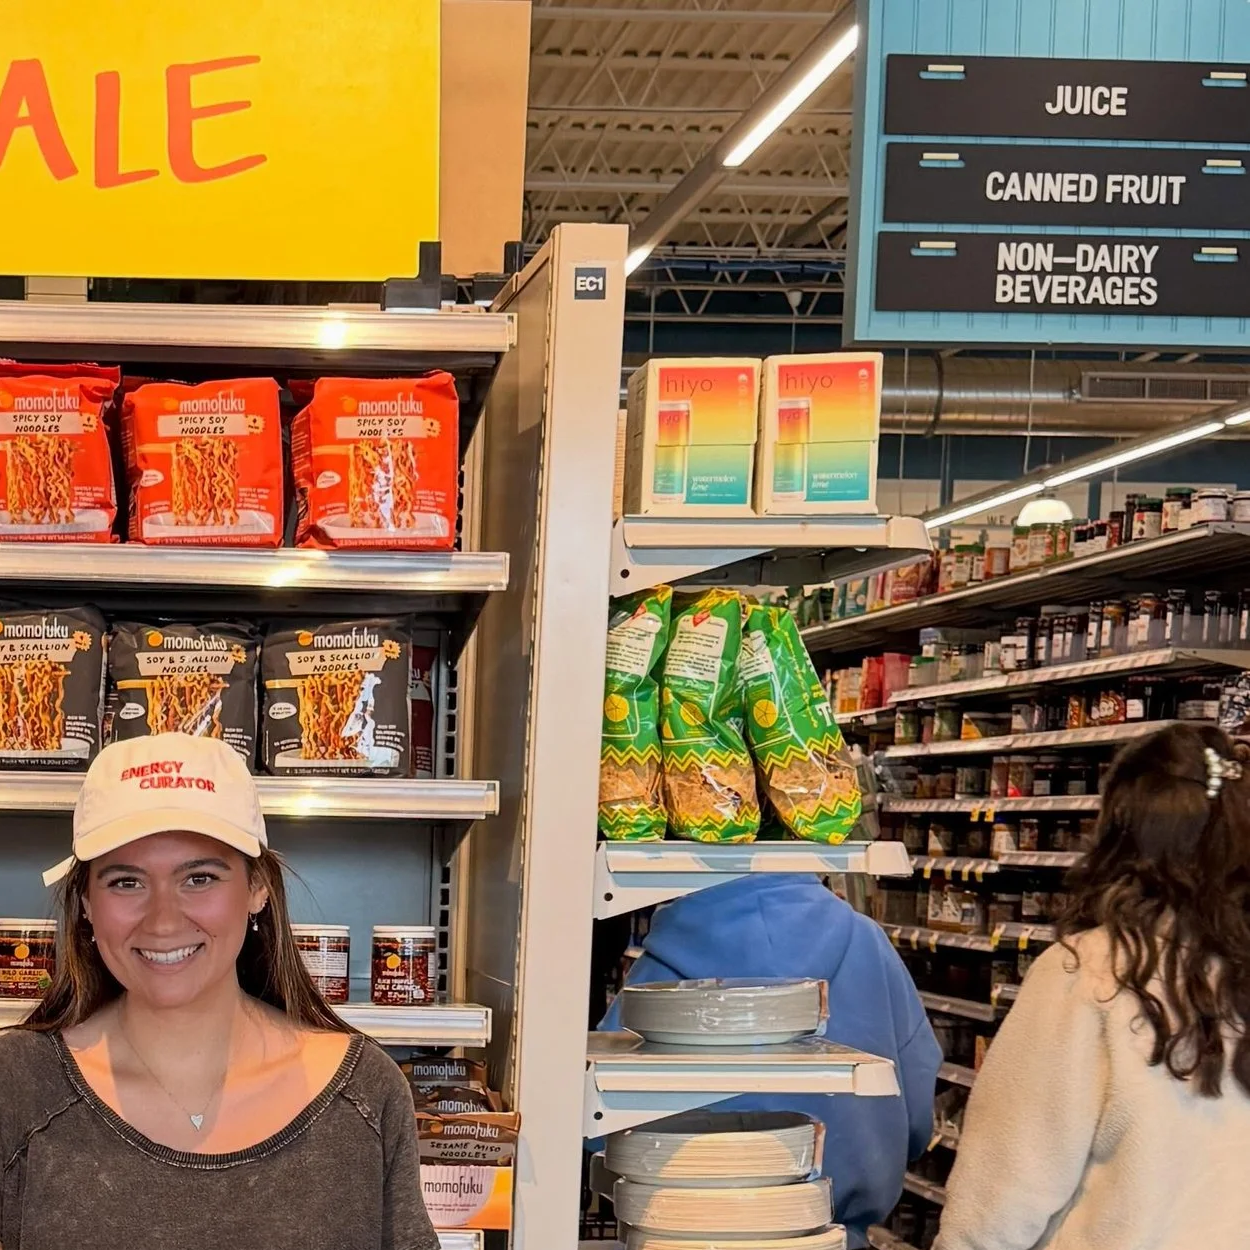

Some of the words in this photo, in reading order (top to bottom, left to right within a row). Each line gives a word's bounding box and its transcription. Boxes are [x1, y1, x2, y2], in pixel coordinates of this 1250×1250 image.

[1045, 85, 1128, 116] JUICE
[985, 171, 1098, 203] CANNED
[1105, 175, 1186, 205] FRUIT
[575, 276, 604, 291] EC1
[995, 275, 1158, 306] BEVERAGES
[665, 375, 713, 396] hiyo
[784, 371, 833, 393] hiyo
[14, 390, 80, 412] momofuku
[180, 392, 246, 414] momofuku
[358, 393, 423, 416] momofuku
[12, 414, 39, 423] SPICY
[43, 414, 63, 423] SOY
[178, 416, 204, 425] SPICY
[208, 416, 228, 425] SOY
[357, 418, 383, 427] SPICY
[387, 418, 407, 427] SOY
[15, 425, 60, 433] NOODLES
[181, 426, 225, 435] NOODLES
[3, 617, 69, 639] momofuku
[163, 634, 227, 651] momofuku
[313, 627, 379, 649] momofuku
[20, 643, 70, 652] SCALLION
[2, 653, 50, 662] NOODLES
[146, 656, 169, 664] SOY
[179, 654, 229, 664] SALLION
[296, 655, 318, 664] SOY
[162, 664, 208, 674] NOODLES
[313, 662, 359, 673] NOODLES
[121, 761, 184, 782] ENERGY
[139, 776, 216, 793] CURATOR
[414, 1062, 467, 1080] momofuku
[443, 1122, 500, 1139] momofuku
[430, 1141, 470, 1149] SESAME
[474, 1143, 501, 1153] MISO
[440, 1151, 487, 1159] NOODLES
[424, 1176, 483, 1198] momofuku
